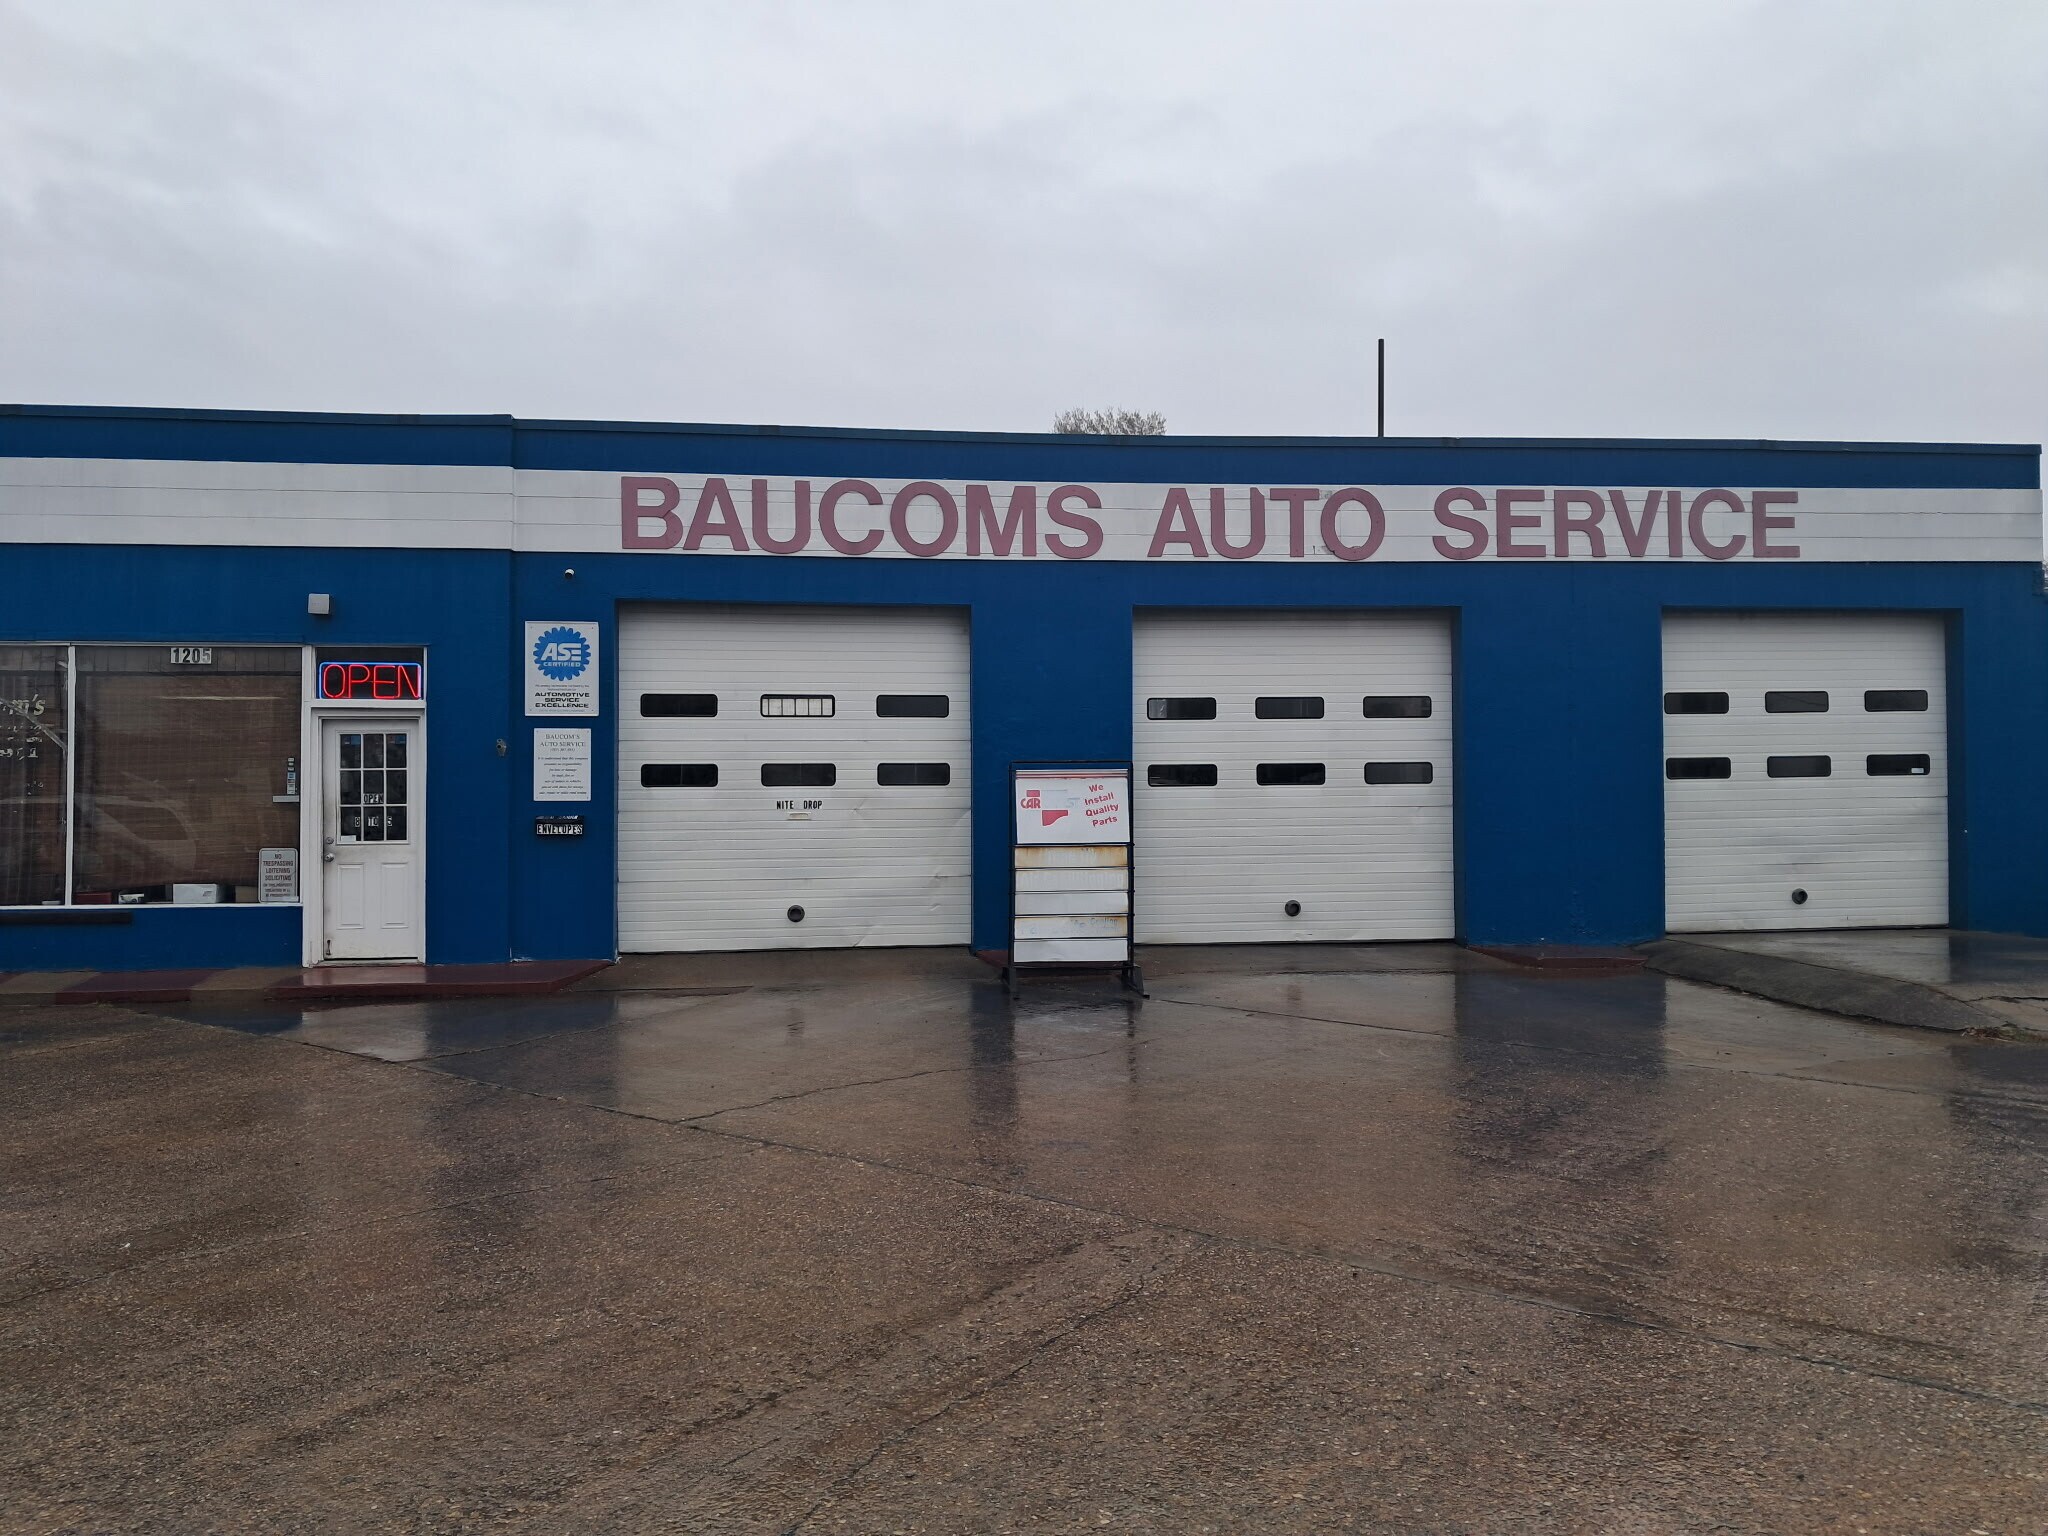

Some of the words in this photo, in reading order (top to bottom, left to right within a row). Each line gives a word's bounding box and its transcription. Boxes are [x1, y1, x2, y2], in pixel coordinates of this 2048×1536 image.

[621, 476, 1104, 559] BAUCOMS
[1147, 487, 1386, 562] AUTO
[1432, 487, 1800, 561] SERVICE
[171, 648, 211, 664] 1205
[541, 642, 582, 662] ASE
[323, 664, 419, 699] OPEN
[1088, 784, 1104, 792] We
[363, 793, 384, 804] OPEN
[776, 800, 794, 810] NITE
[803, 800, 823, 810] DROP
[1020, 798, 1041, 809] CAR
[1084, 792, 1114, 806] Install
[1085, 803, 1119, 817] Quality
[1092, 816, 1118, 827] Parts
[536, 823, 583, 835] ENVELOPES
